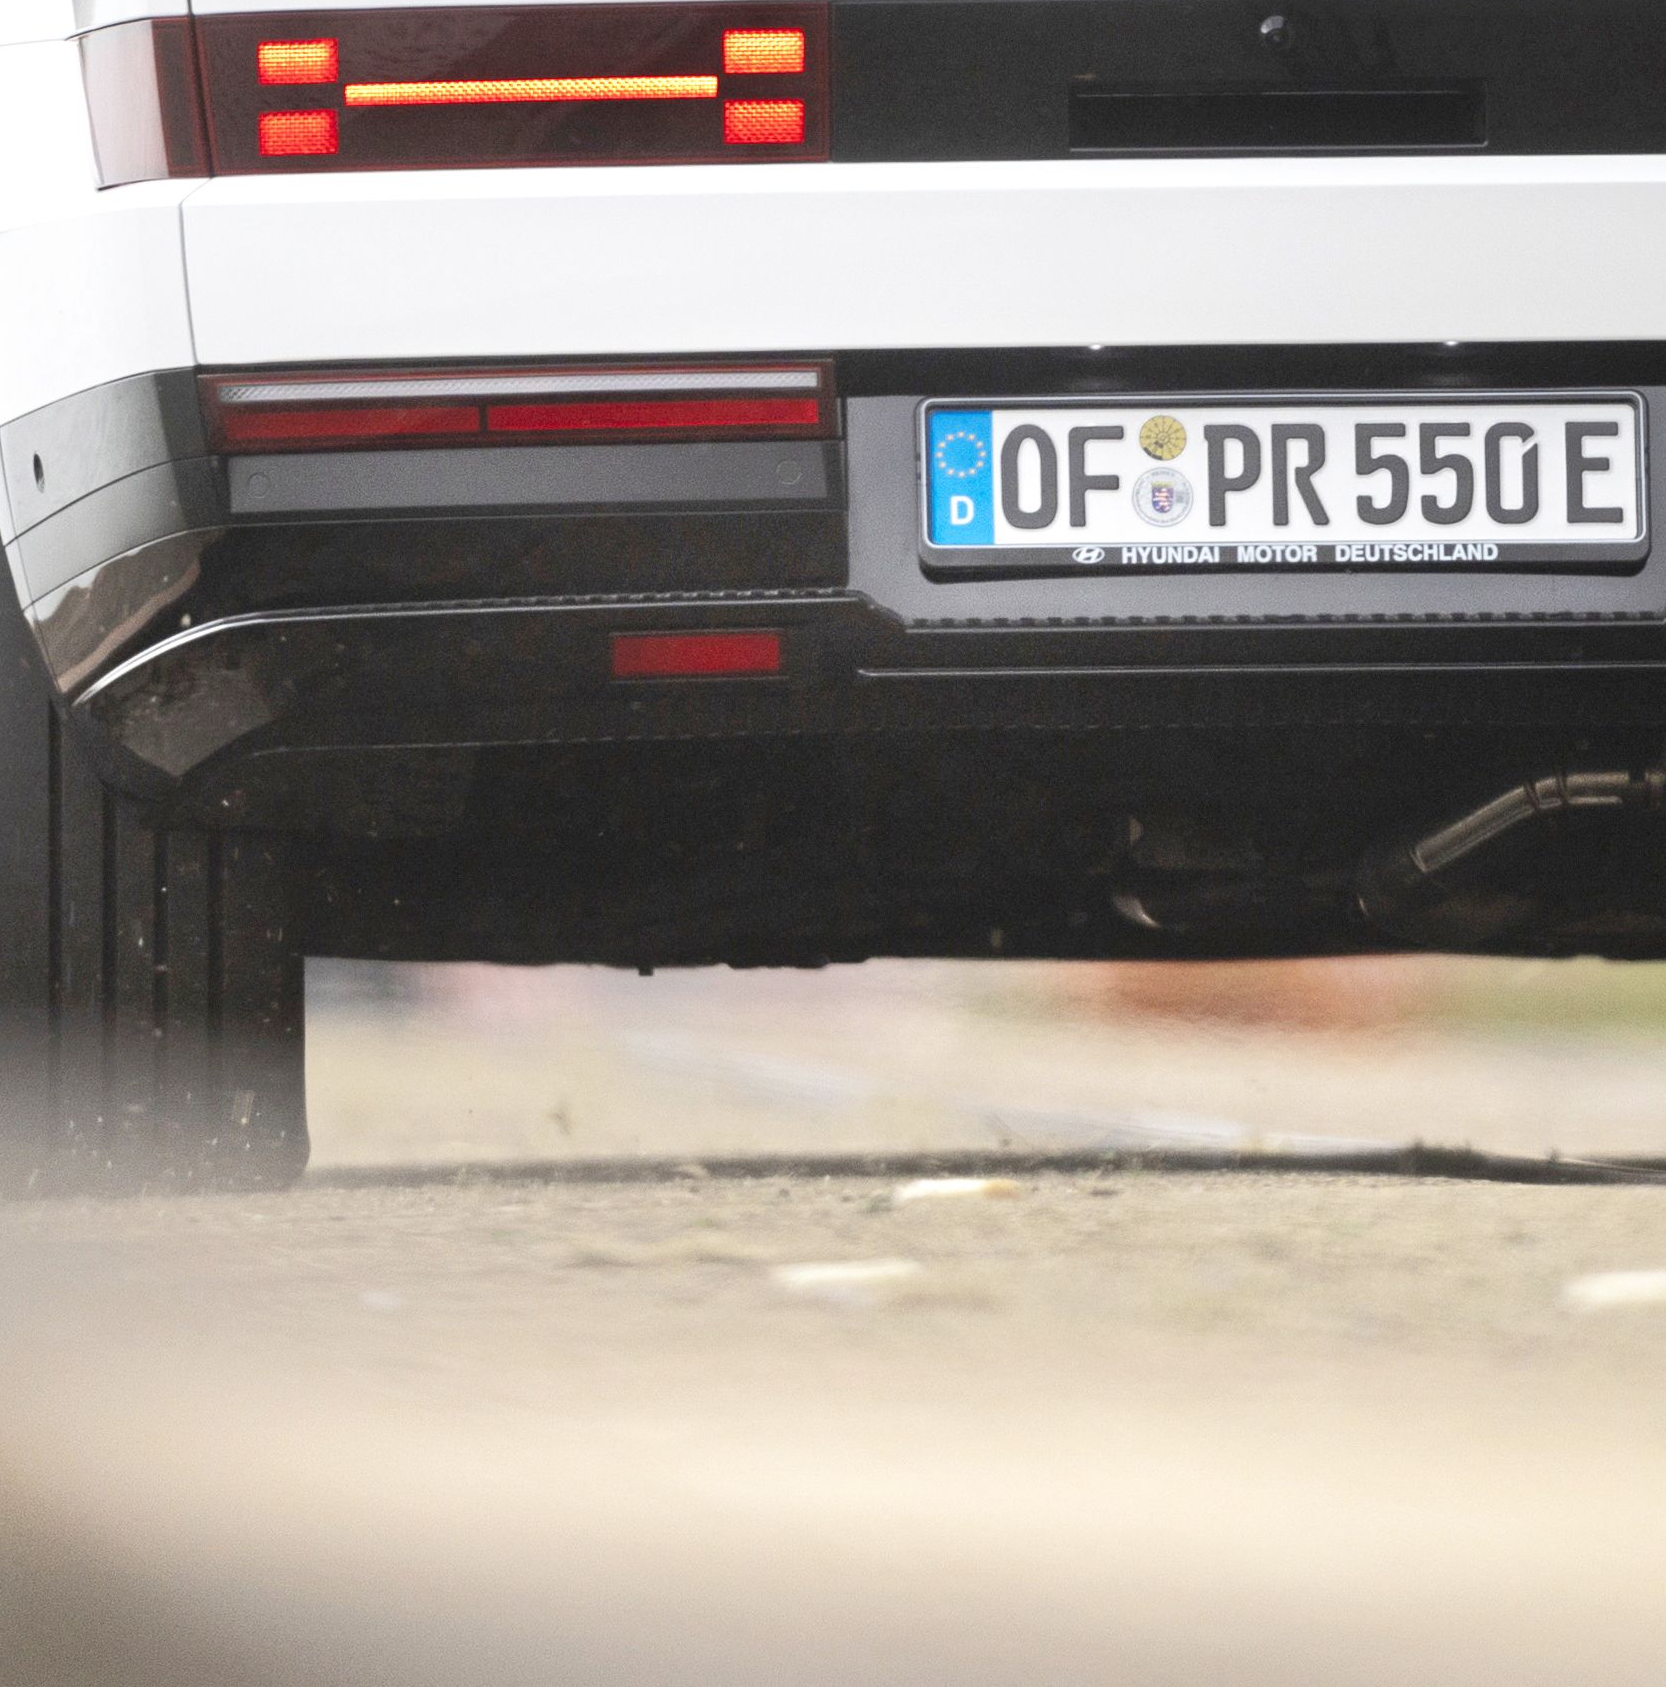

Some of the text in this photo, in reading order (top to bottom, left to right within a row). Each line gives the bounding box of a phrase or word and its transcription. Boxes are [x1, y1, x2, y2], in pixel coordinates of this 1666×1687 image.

[1000, 424, 1125, 530] OF
[1203, 423, 1330, 527] PR
[949, 495, 975, 526] D
[1121, 544, 1499, 564] HYUNDAI MOTOR DEUTSCHLAND
